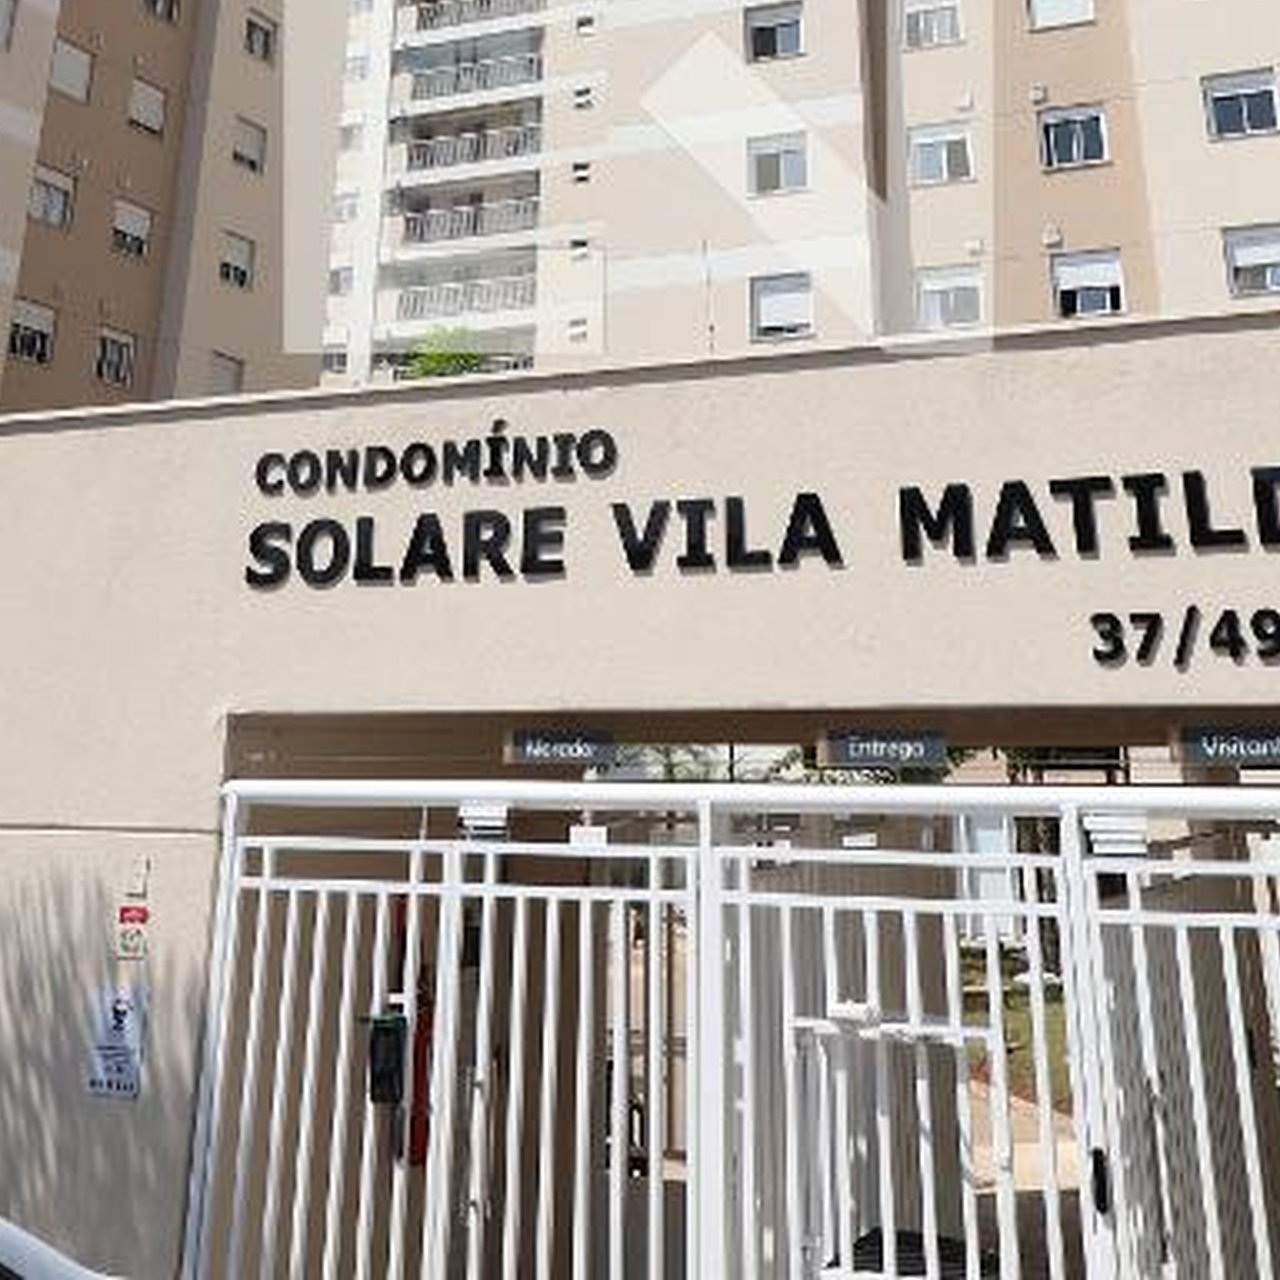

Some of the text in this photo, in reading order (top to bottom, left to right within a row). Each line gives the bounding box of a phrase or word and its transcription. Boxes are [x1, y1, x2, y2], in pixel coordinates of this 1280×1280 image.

[255, 419, 618, 497] CONDOMÍNIO
[245, 506, 567, 589] SOLARE
[611, 492, 846, 576] VILA
